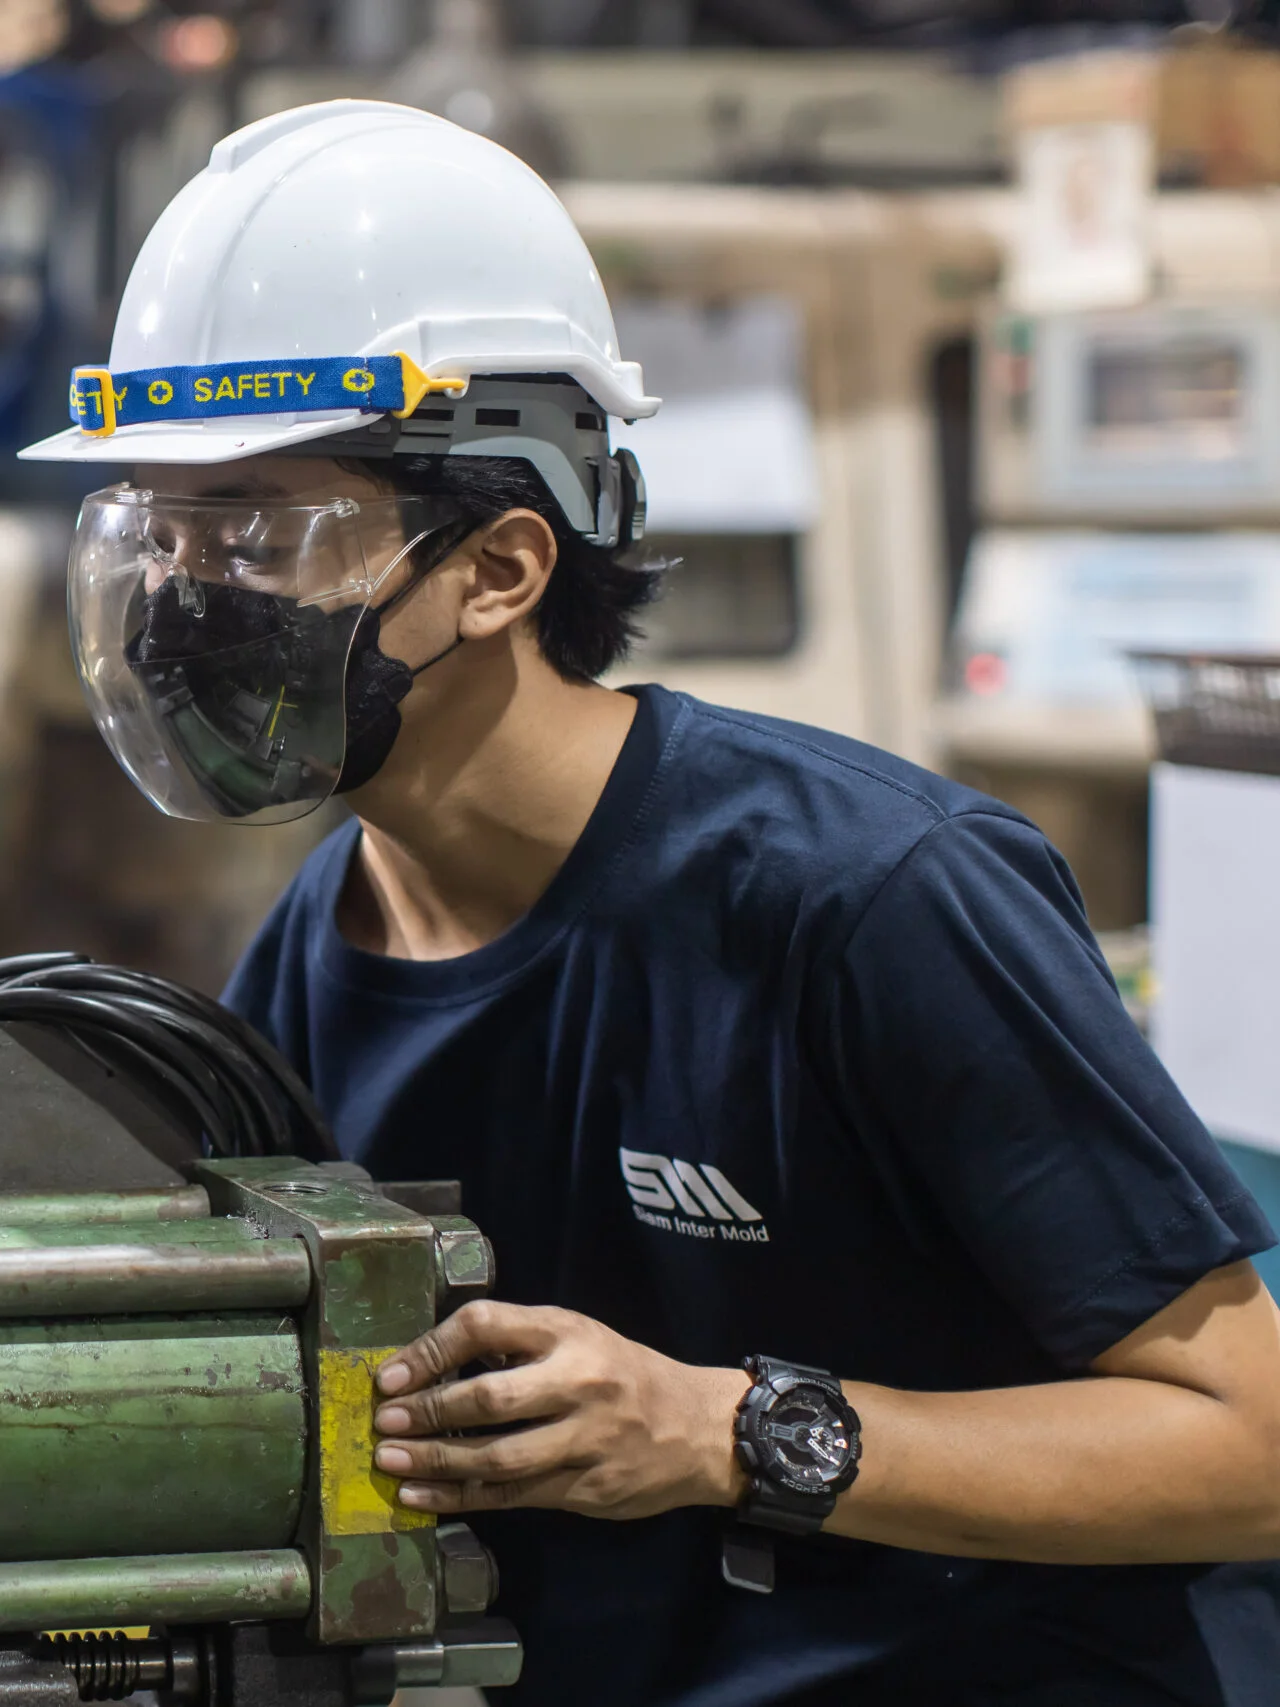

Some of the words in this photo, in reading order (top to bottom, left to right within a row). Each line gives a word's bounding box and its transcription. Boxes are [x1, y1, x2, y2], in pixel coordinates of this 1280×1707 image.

[194, 371, 316, 402] SAFETY
[675, 1216, 716, 1238] Inter
[720, 1224, 770, 1242] Mold
[780, 1475, 831, 1494] G-SHOCK
